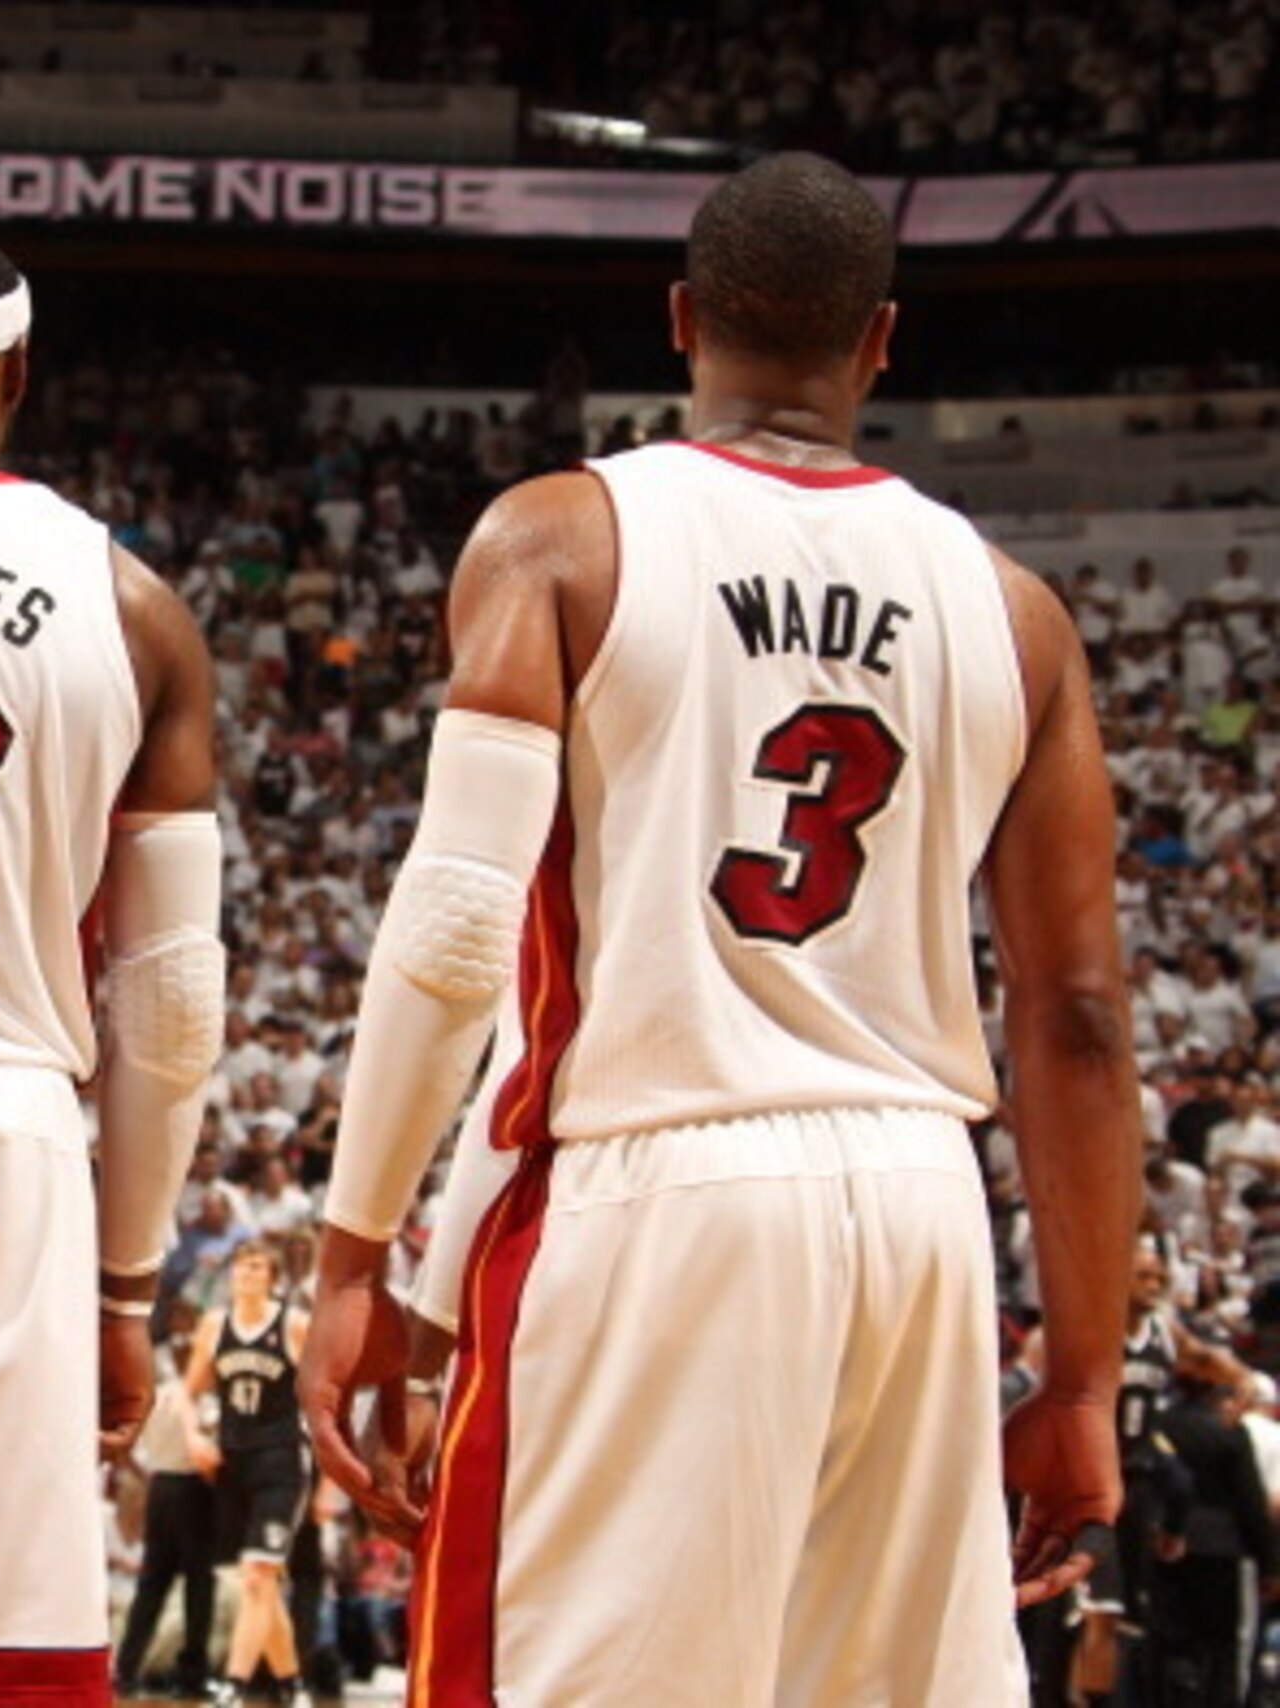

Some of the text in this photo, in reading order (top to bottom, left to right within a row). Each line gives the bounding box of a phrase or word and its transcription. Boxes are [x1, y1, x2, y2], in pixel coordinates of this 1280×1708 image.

[213, 158, 492, 232] NOISE
[717, 575, 913, 677] WADE
[708, 702, 908, 948] 3
